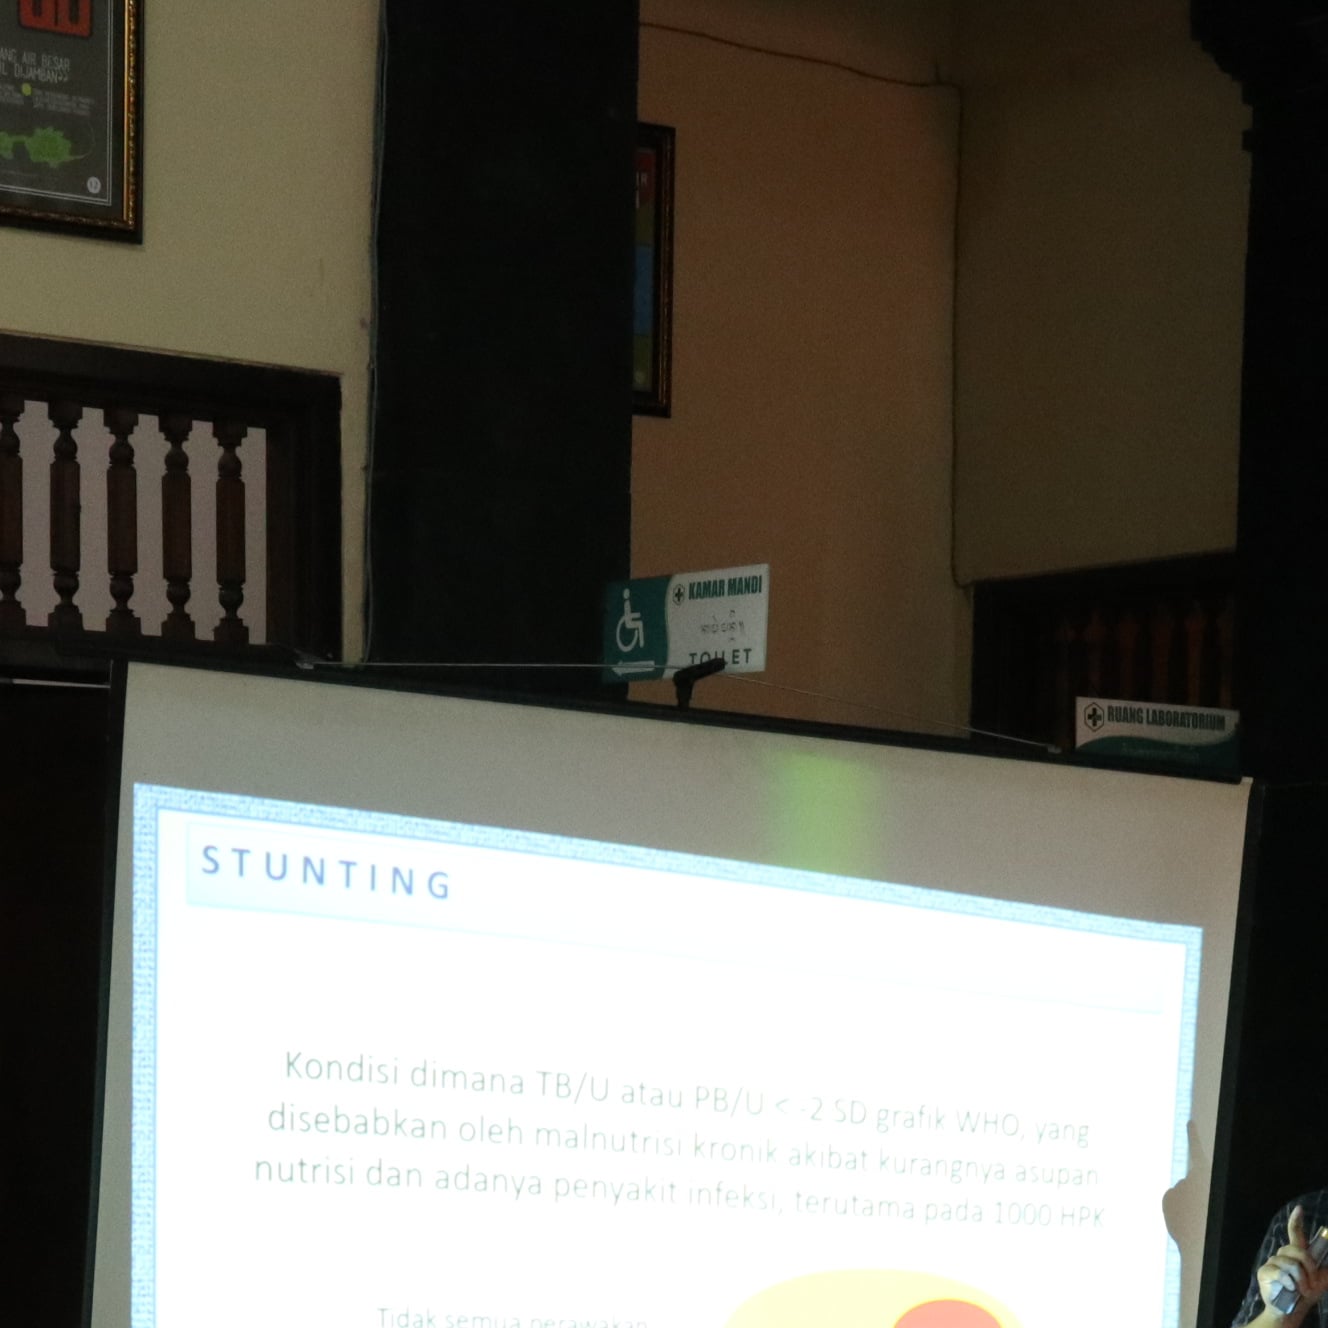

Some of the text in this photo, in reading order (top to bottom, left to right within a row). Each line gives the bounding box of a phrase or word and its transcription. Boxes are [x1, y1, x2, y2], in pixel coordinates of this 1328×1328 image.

[689, 576, 762, 600] KAMAR MANDI
[1108, 705, 1225, 731] RUANG LABORATORIUM
[202, 845, 449, 899] STUNTING
[285, 1051, 399, 1084] Kondisi
[410, 1060, 524, 1096] dimana
[535, 1070, 609, 1104] TB/U
[620, 1081, 683, 1109] atau
[695, 1086, 763, 1118] PB/U
[834, 1098, 867, 1124] SD
[876, 1104, 946, 1134] grafik
[957, 1109, 1024, 1142] WHO,
[1036, 1122, 1089, 1148] yang
[268, 1102, 1098, 1190] disebabkan oleh malnutrisi kronik akibat kurangnya asupan
[255, 1156, 1105, 1228] nutrisi dan adanya penyakit infeksi, terutama pada 1000 HPK
[377, 1304, 436, 1328] Tidak
